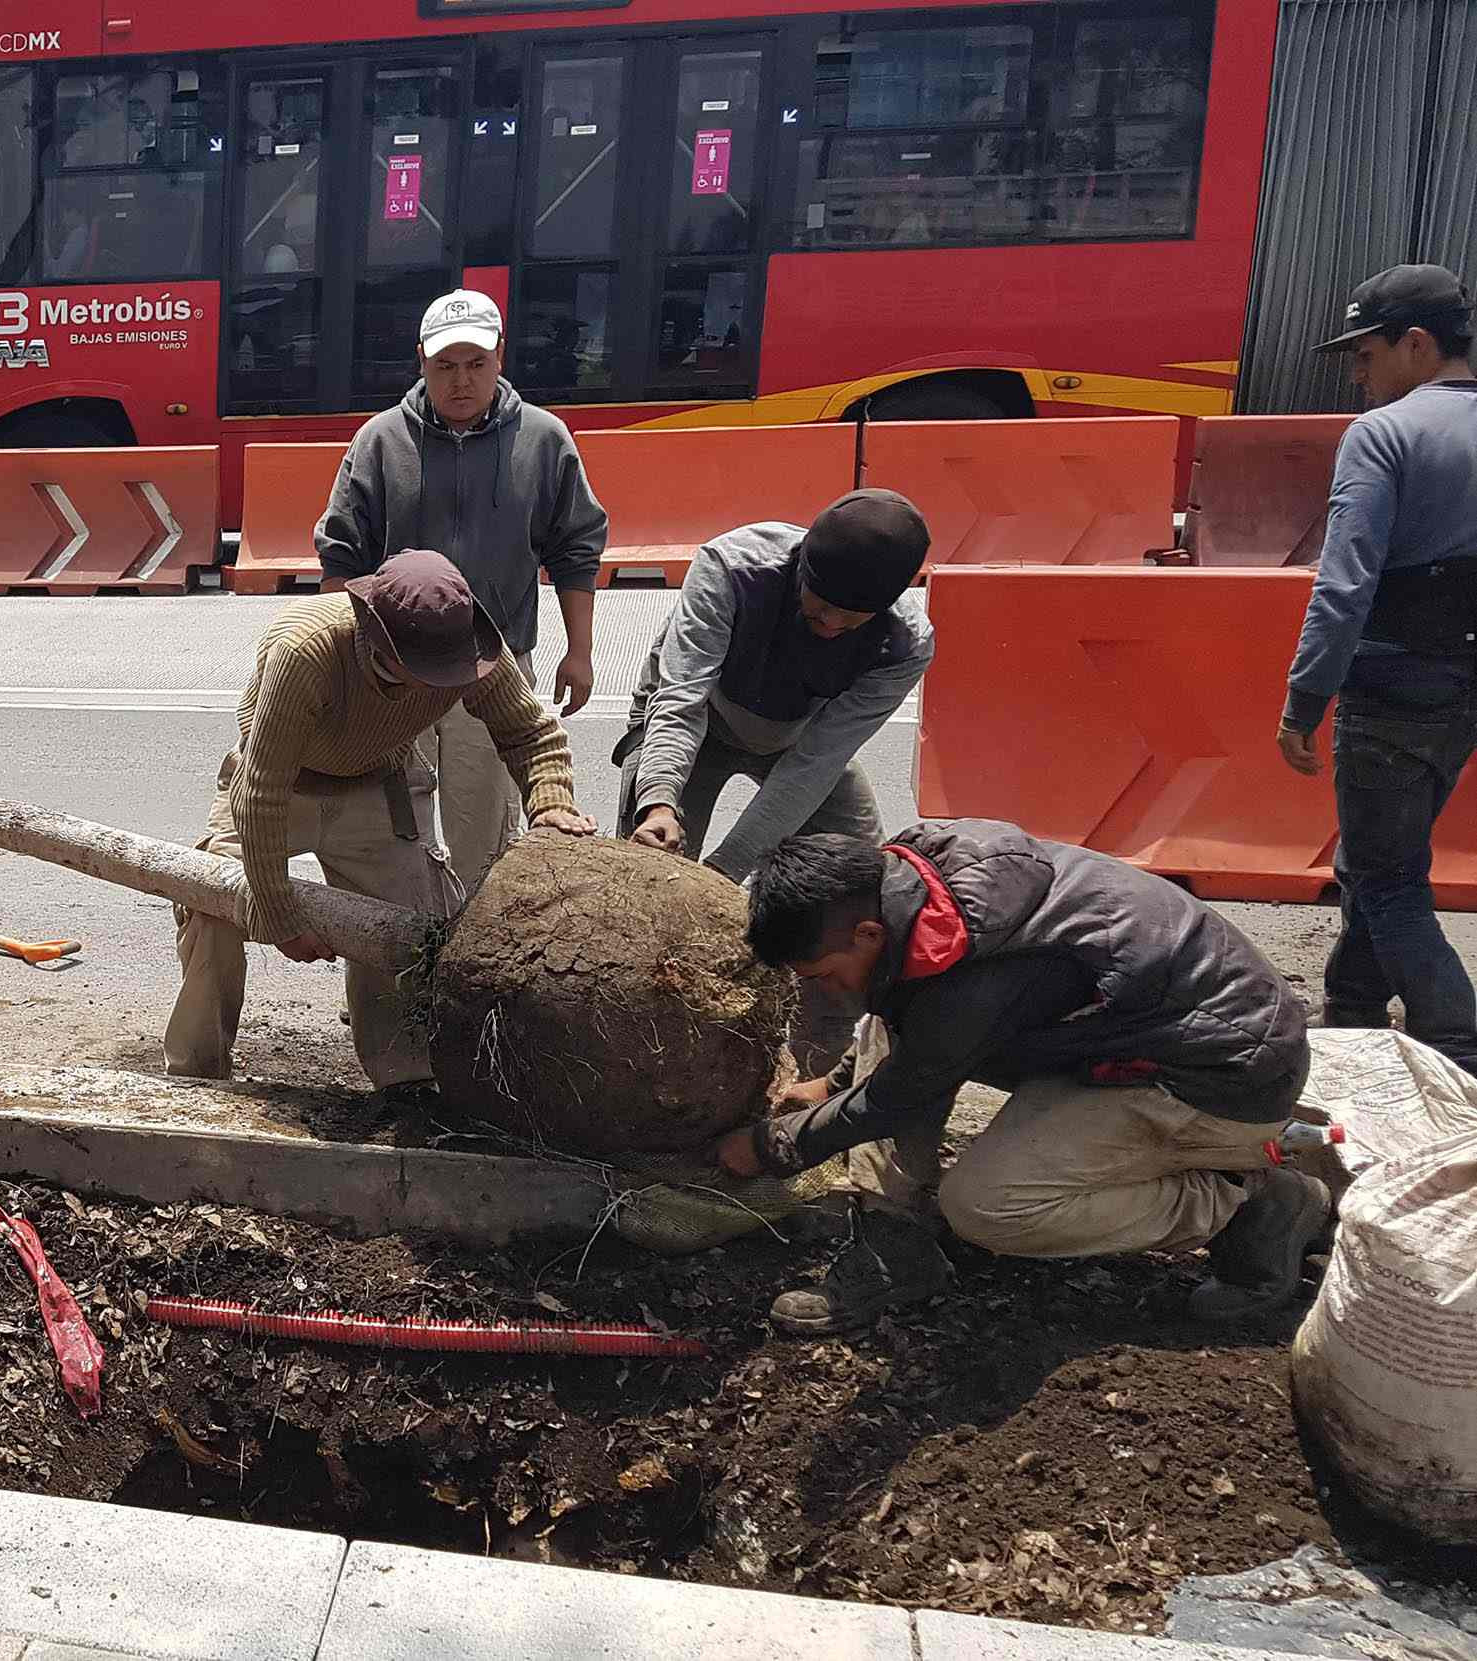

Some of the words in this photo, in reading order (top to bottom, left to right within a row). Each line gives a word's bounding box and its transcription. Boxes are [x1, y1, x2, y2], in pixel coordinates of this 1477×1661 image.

[40, 292, 192, 326] Metrobús
[69, 332, 113, 345] BAJAS
[116, 330, 188, 343] EMISIONES
[159, 342, 180, 350] EURO
[181, 341, 188, 349] V
